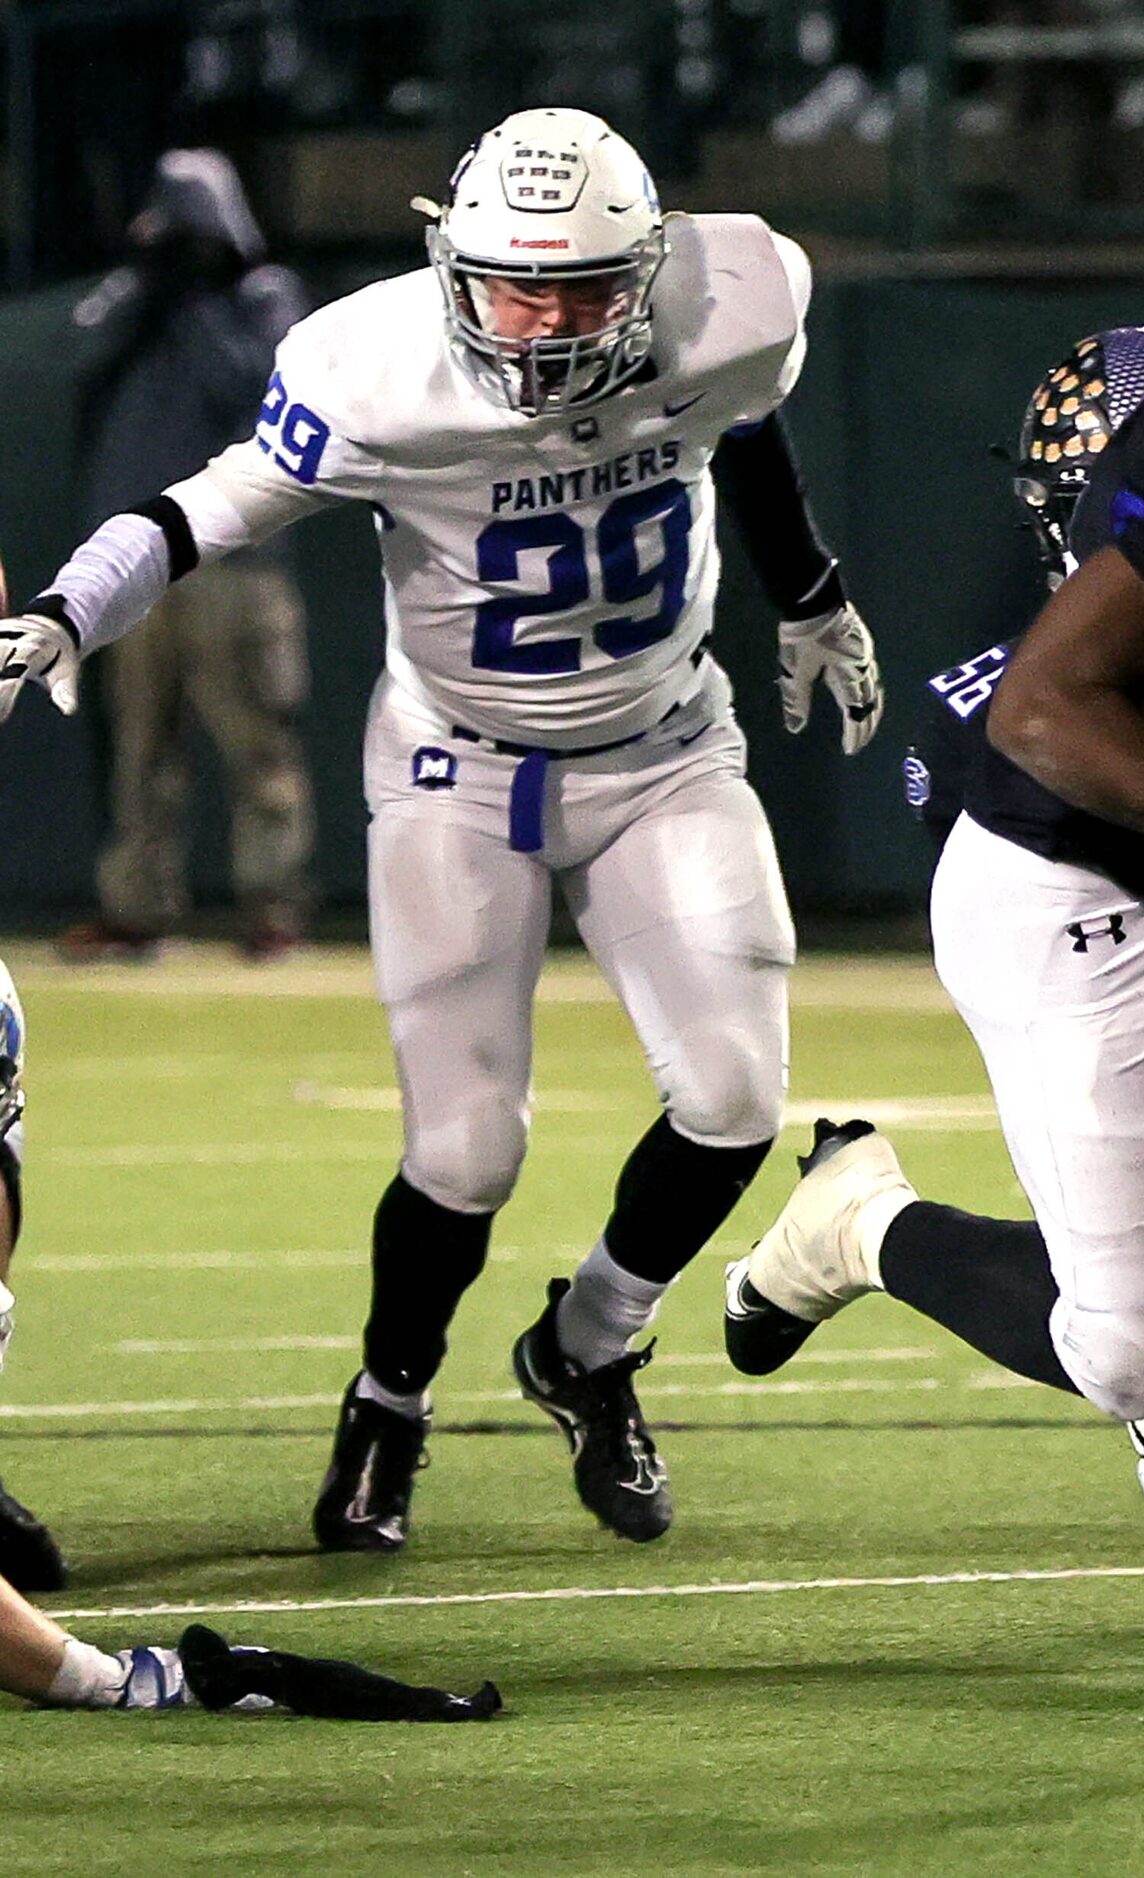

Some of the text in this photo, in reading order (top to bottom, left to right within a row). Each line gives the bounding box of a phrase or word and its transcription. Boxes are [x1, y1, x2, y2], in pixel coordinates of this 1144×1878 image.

[256, 370, 331, 485] 29
[491, 440, 682, 513] PANTHERS
[471, 477, 692, 675] 29
[927, 644, 1007, 722] 56
